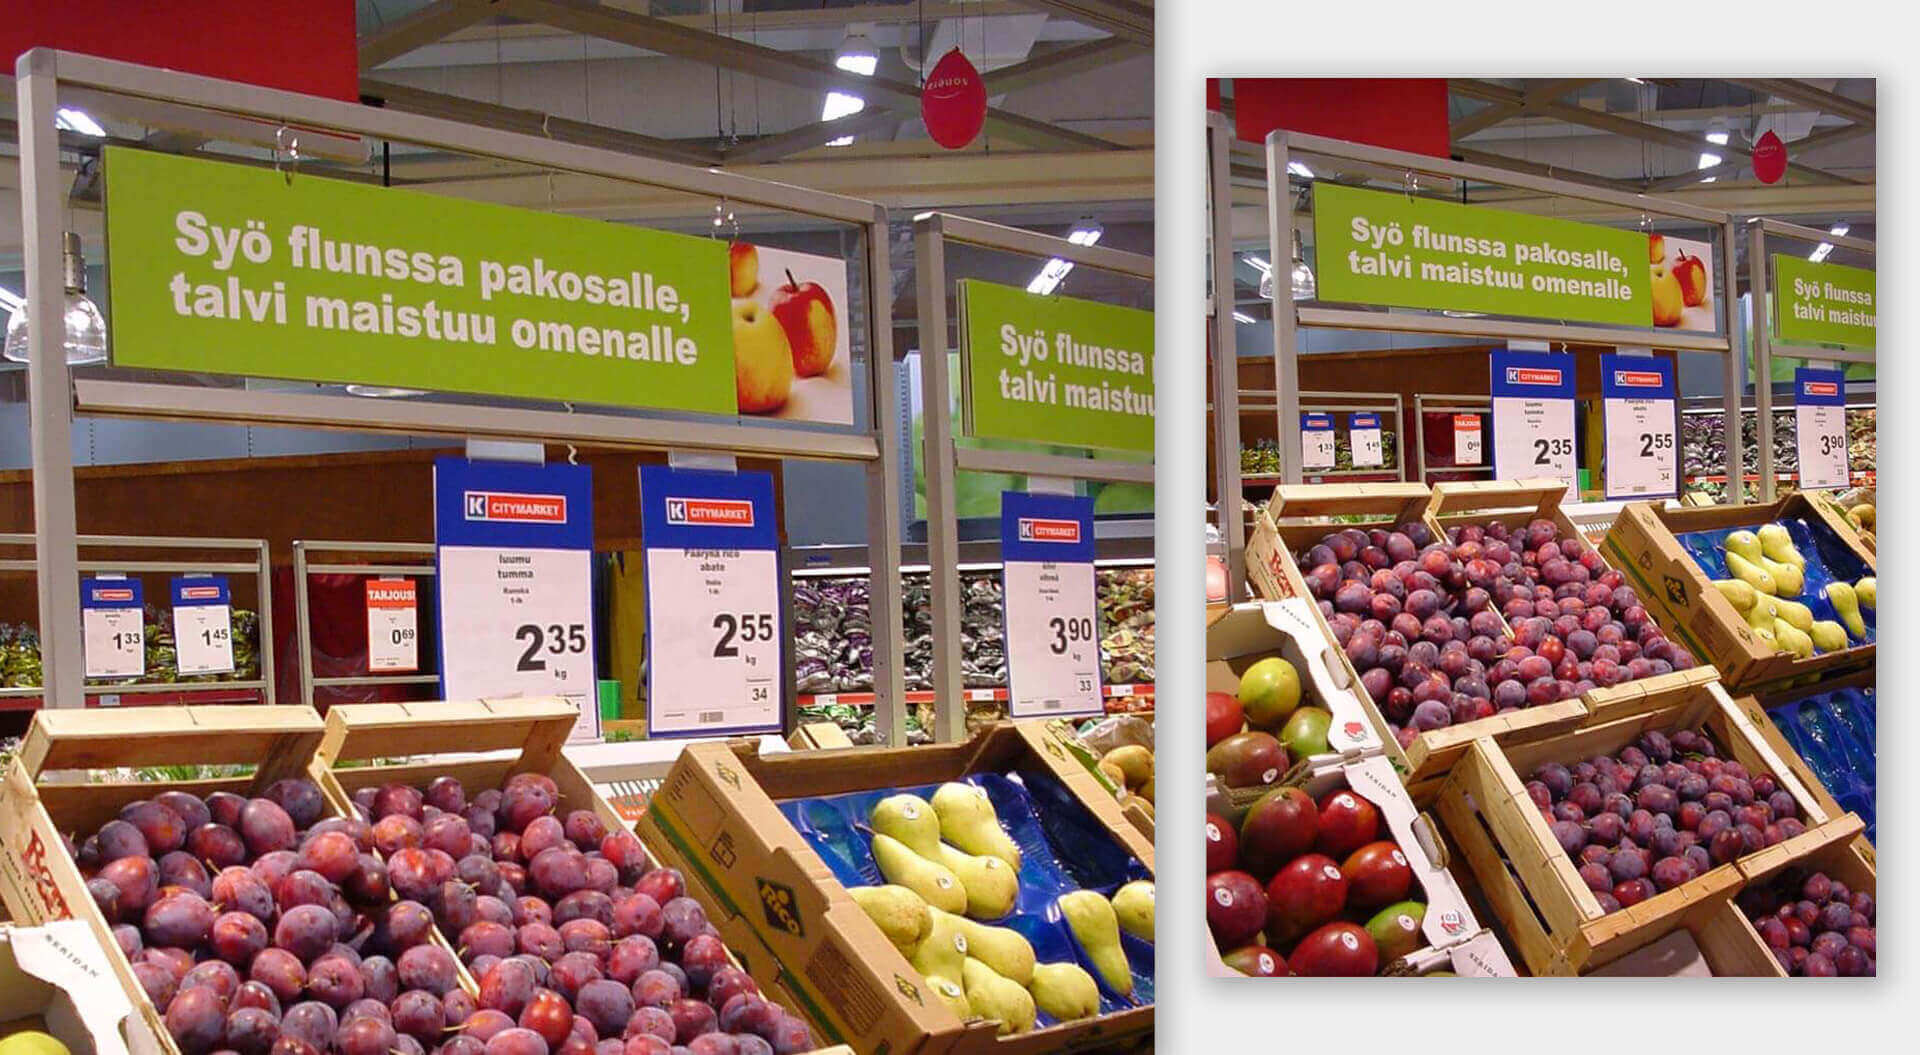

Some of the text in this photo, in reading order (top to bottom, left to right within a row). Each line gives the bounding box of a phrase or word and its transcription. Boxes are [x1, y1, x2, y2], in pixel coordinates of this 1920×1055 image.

[1351, 216, 1628, 277] Syö flunssa pakosalle,
[175, 211, 690, 323] Syö flunssa pakosalle,
[1348, 250, 1632, 300] talvi maistuu omenalle
[1794, 277, 1872, 306] Syö flunssa
[169, 272, 697, 365] talvi maistuu omenalle
[1793, 302, 1825, 321] talvi
[1000, 324, 1049, 367] Syö
[1056, 333, 1145, 375] flunssa
[999, 368, 1057, 405] talvi
[469, 496, 559, 516] K CITYMARKET
[670, 502, 747, 520] K CITYMARKET
[1021, 521, 1032, 538] K
[498, 570, 534, 579] tumma
[745, 654, 756, 666] kg
[554, 668, 567, 680] kg
[752, 687, 768, 701] 34
[1079, 680, 1092, 691] 33
